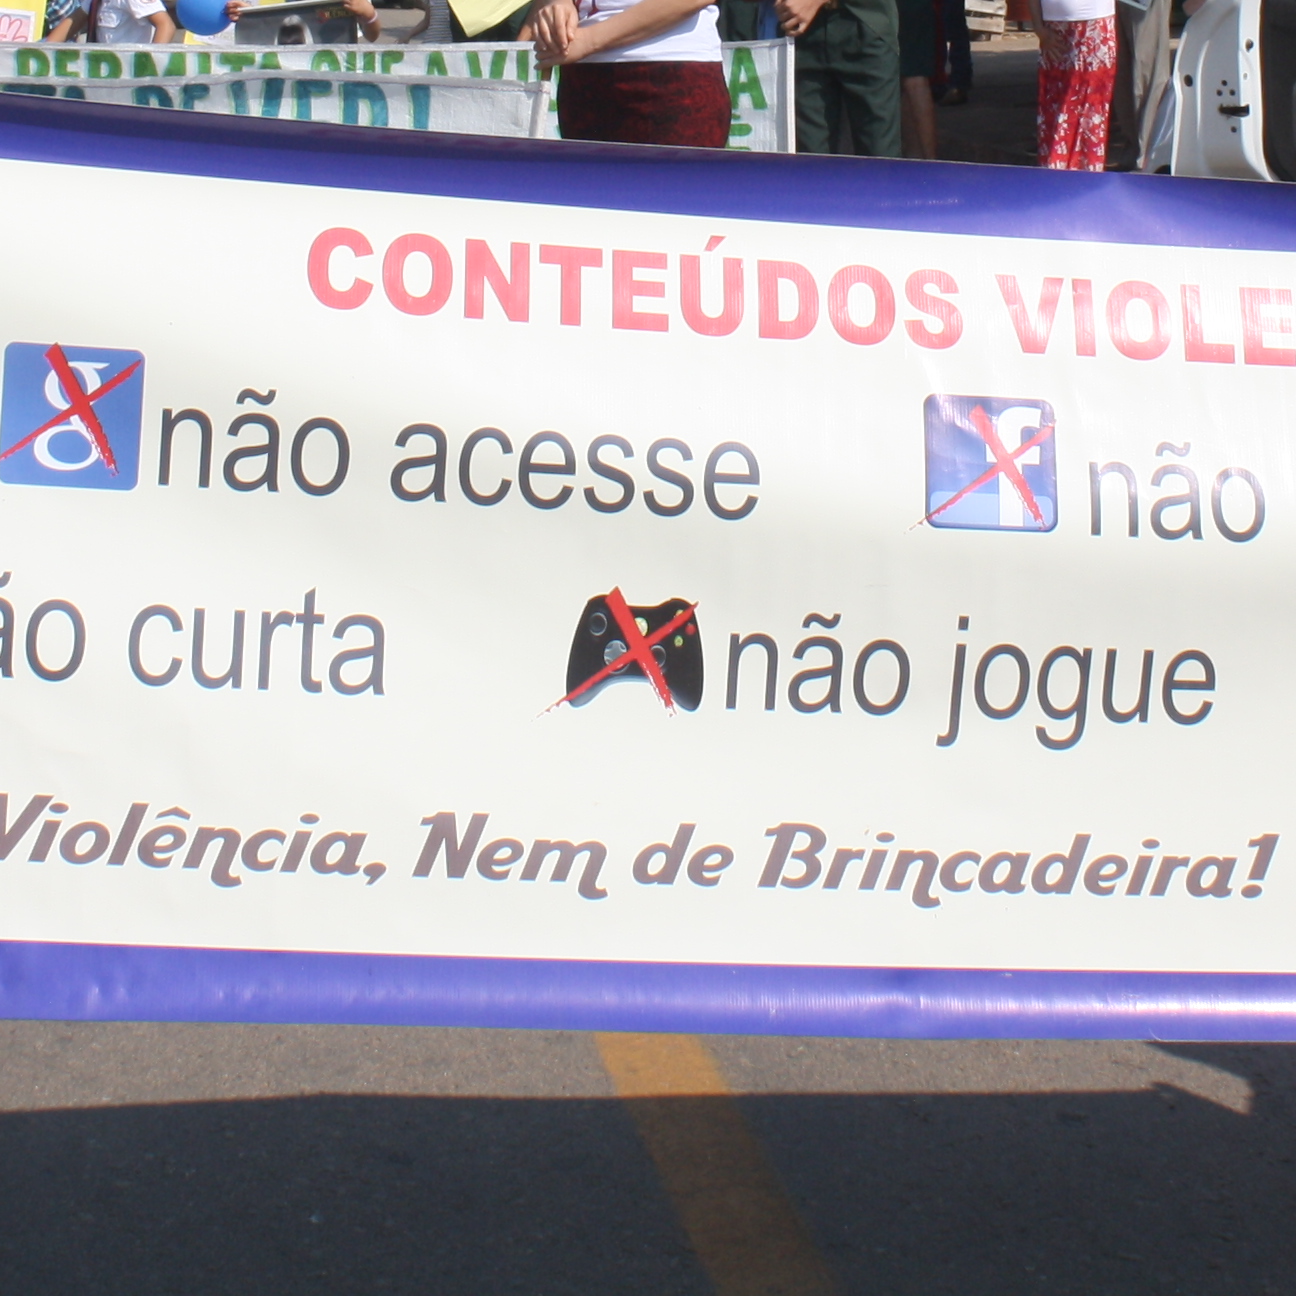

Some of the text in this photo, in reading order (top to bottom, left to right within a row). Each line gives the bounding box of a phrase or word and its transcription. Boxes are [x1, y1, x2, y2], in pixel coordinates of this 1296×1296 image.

[306, 227, 964, 350] CONTEÚDOS
[158, 388, 352, 497] não
[390, 422, 761, 520] acesse
[1088, 441, 1266, 544] não
[128, 586, 387, 696] curta
[725, 612, 1217, 751] não jogue
[411, 811, 609, 901] Nem
[631, 822, 735, 887] de
[757, 821, 1280, 909] Brincadeira!
